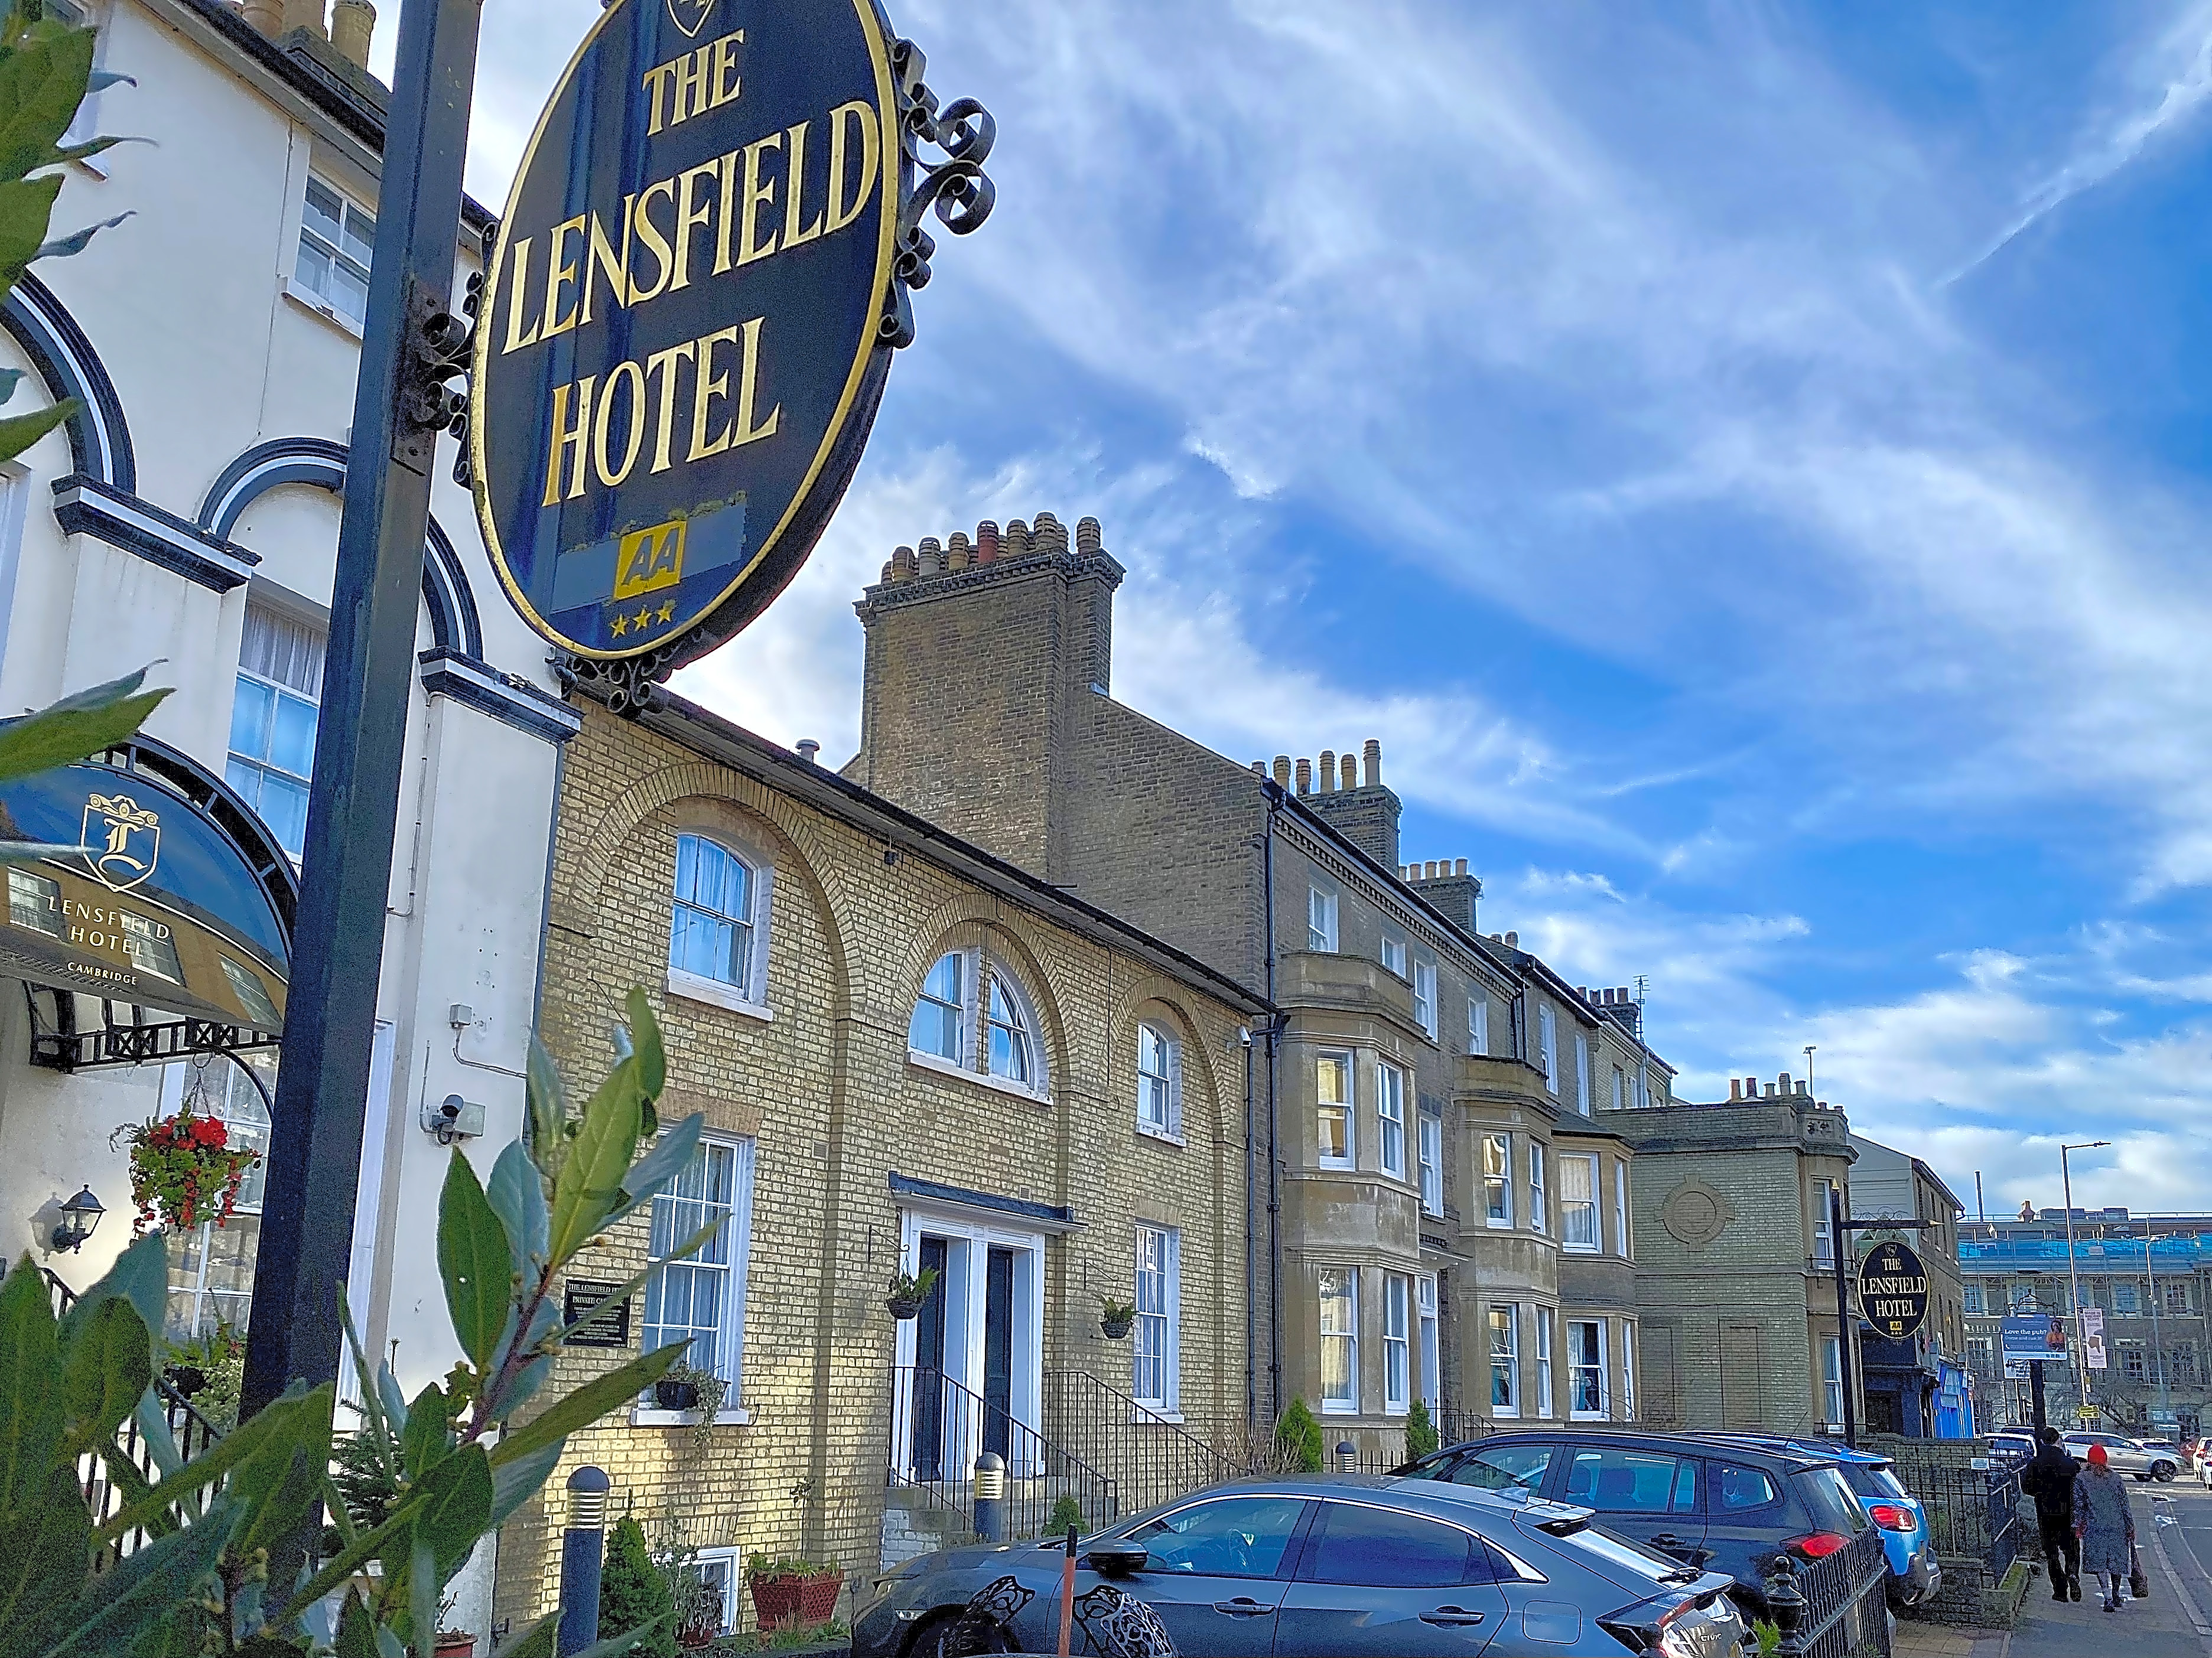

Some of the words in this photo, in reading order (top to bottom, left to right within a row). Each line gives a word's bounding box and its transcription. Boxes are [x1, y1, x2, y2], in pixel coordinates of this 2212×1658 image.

[643, 29, 746, 137] THE
[501, 100, 879, 355] LENSFIELD
[541, 317, 781, 508] HOTEL
[621, 526, 680, 585] AA
[48, 895, 170, 939] LENSFIELD
[70, 926, 144, 957] HOTEL
[67, 962, 137, 986] CAMBRIDGE
[1882, 1258, 1902, 1271] THE
[1861, 1276, 1927, 1295] LENSFIELD
[1875, 1299, 1917, 1317] HOTEL
[1701, 1633, 1722, 1641] CIVIC
